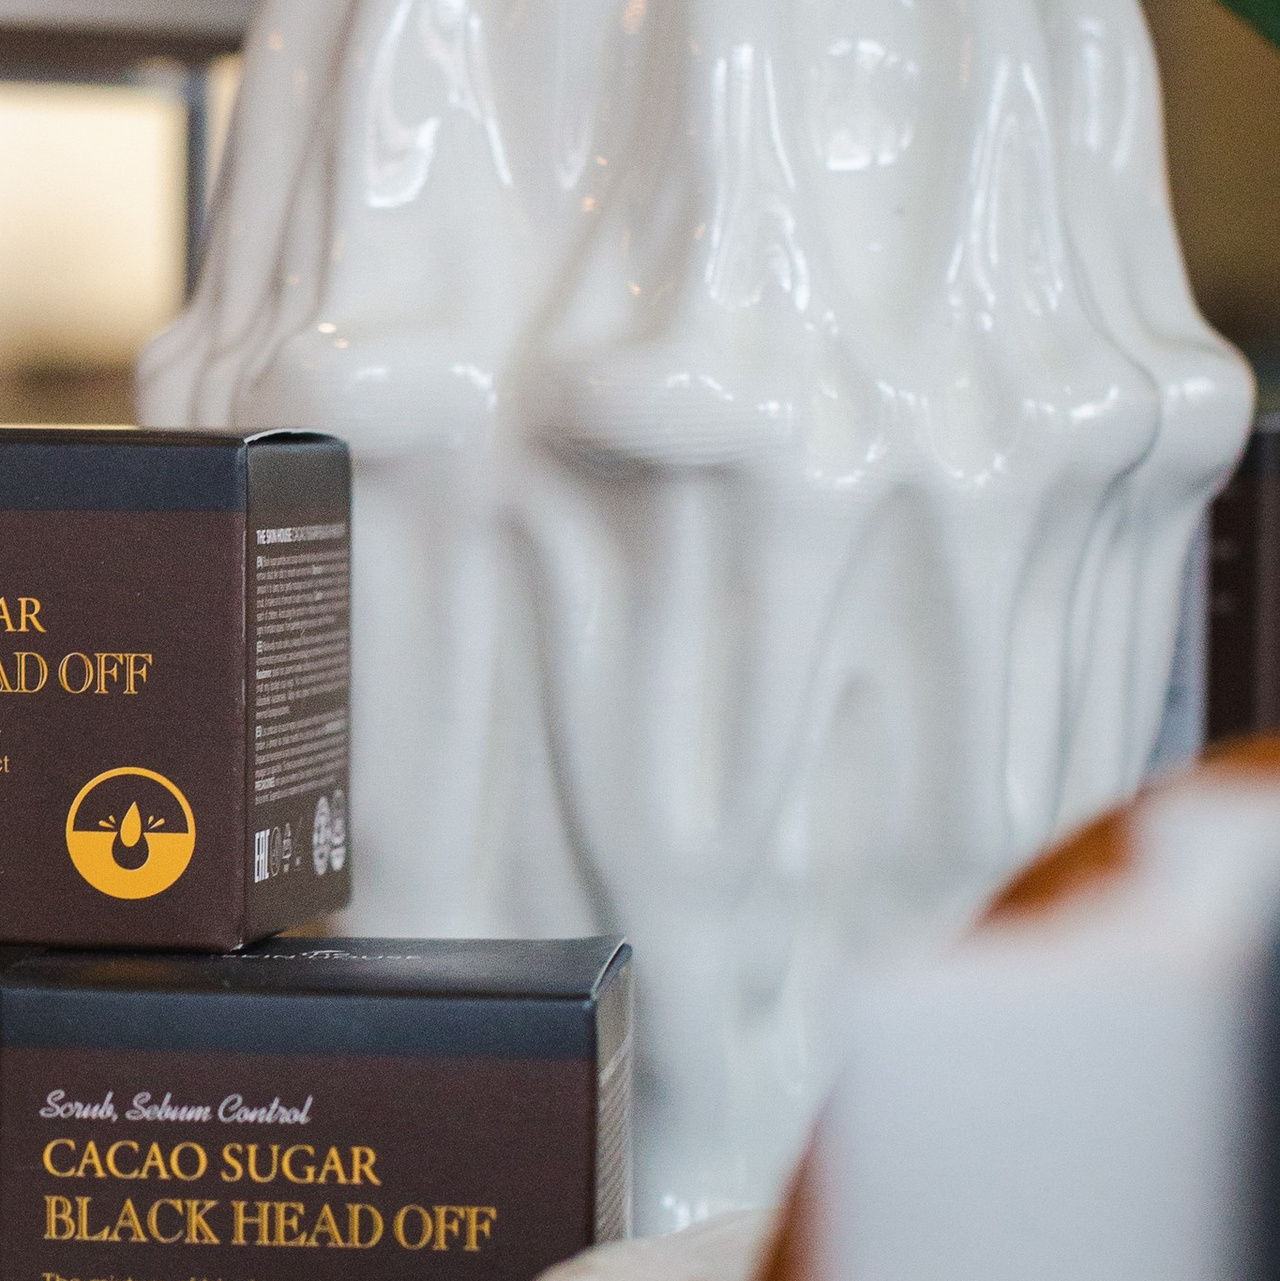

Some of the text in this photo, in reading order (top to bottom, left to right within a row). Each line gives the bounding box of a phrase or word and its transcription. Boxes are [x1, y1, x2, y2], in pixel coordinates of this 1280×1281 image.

[58, 652, 153, 694] OFF
[218, 1094, 313, 1124] Control
[43, 1139, 381, 1185] CACAO SUGAR
[44, 1196, 497, 1251] BLACK HEAD OFF
